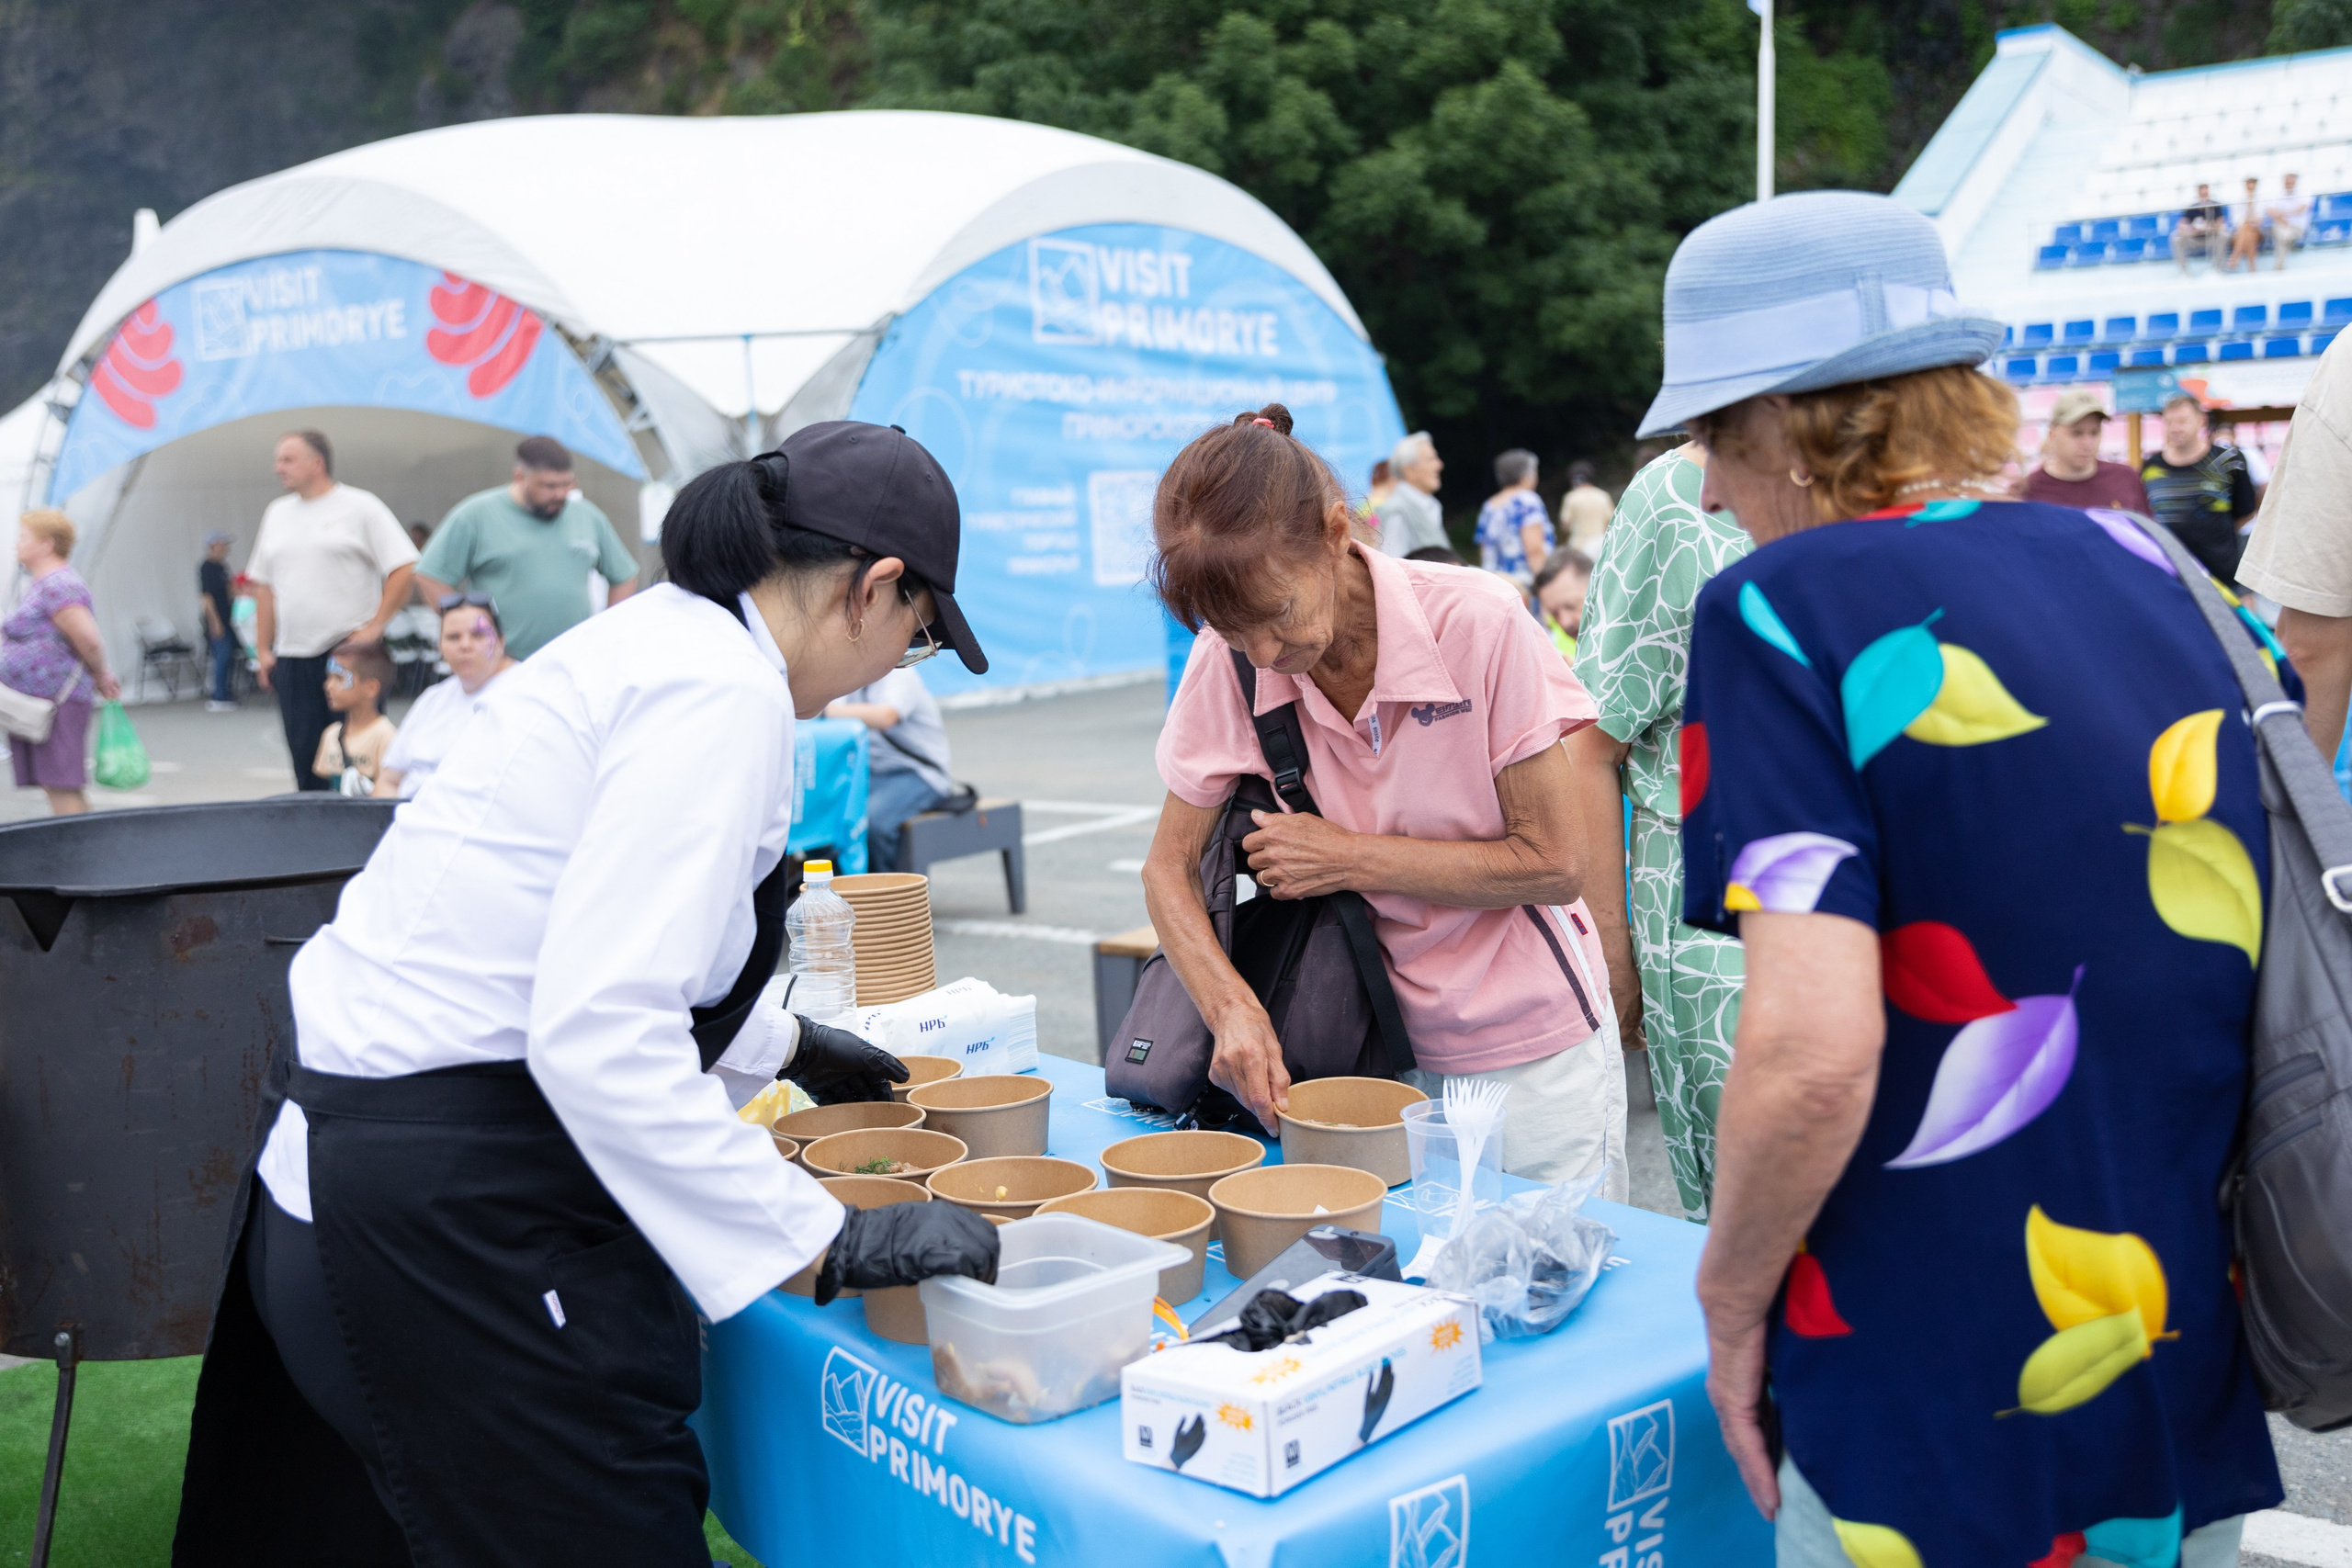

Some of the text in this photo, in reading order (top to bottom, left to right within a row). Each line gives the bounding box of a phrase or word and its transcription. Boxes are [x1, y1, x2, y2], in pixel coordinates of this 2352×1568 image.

[244, 265, 321, 311] VISIT
[1100, 246, 1192, 298] VISIT
[248, 298, 407, 356] PRIMORYE
[1103, 304, 1281, 355] PRIMORYE
[1434, 709, 1460, 722] FASHION
[875, 1375, 958, 1455] VISIT
[870, 1424, 1036, 1564] PRIMORYE
